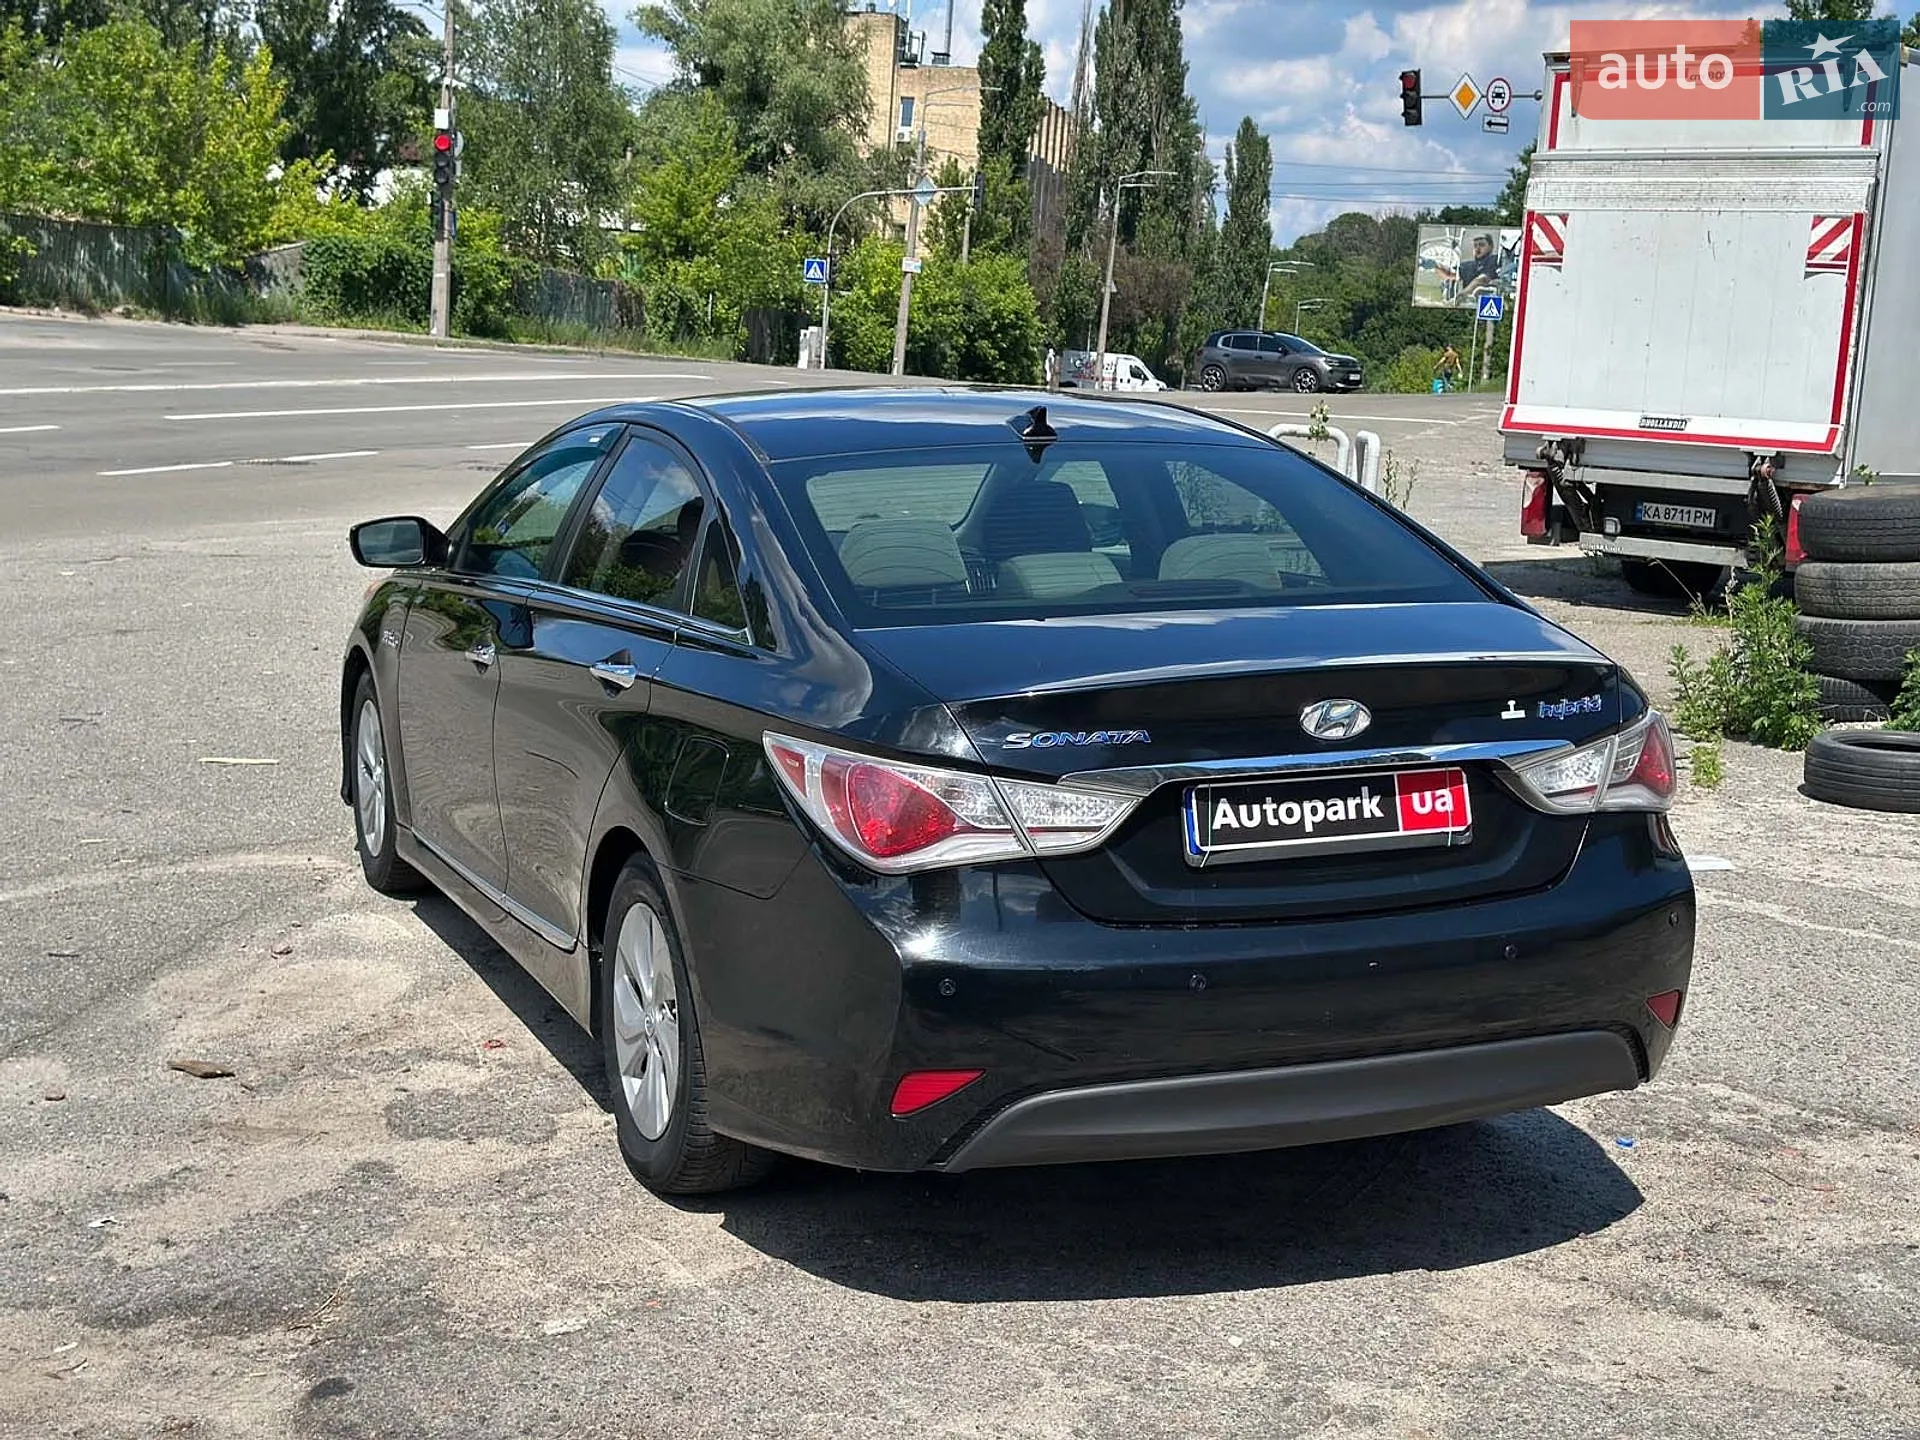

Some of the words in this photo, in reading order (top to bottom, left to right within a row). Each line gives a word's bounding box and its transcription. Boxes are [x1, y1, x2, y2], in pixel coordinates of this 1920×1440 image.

[1643, 504, 1660, 520] KA
[1664, 507, 1691, 522] 8711
[1694, 510, 1713, 525] PM
[1537, 694, 1602, 720] hybrid
[1002, 729, 1152, 750] SONATA
[1212, 785, 1385, 833] Autopark
[1411, 788, 1455, 815] ua
